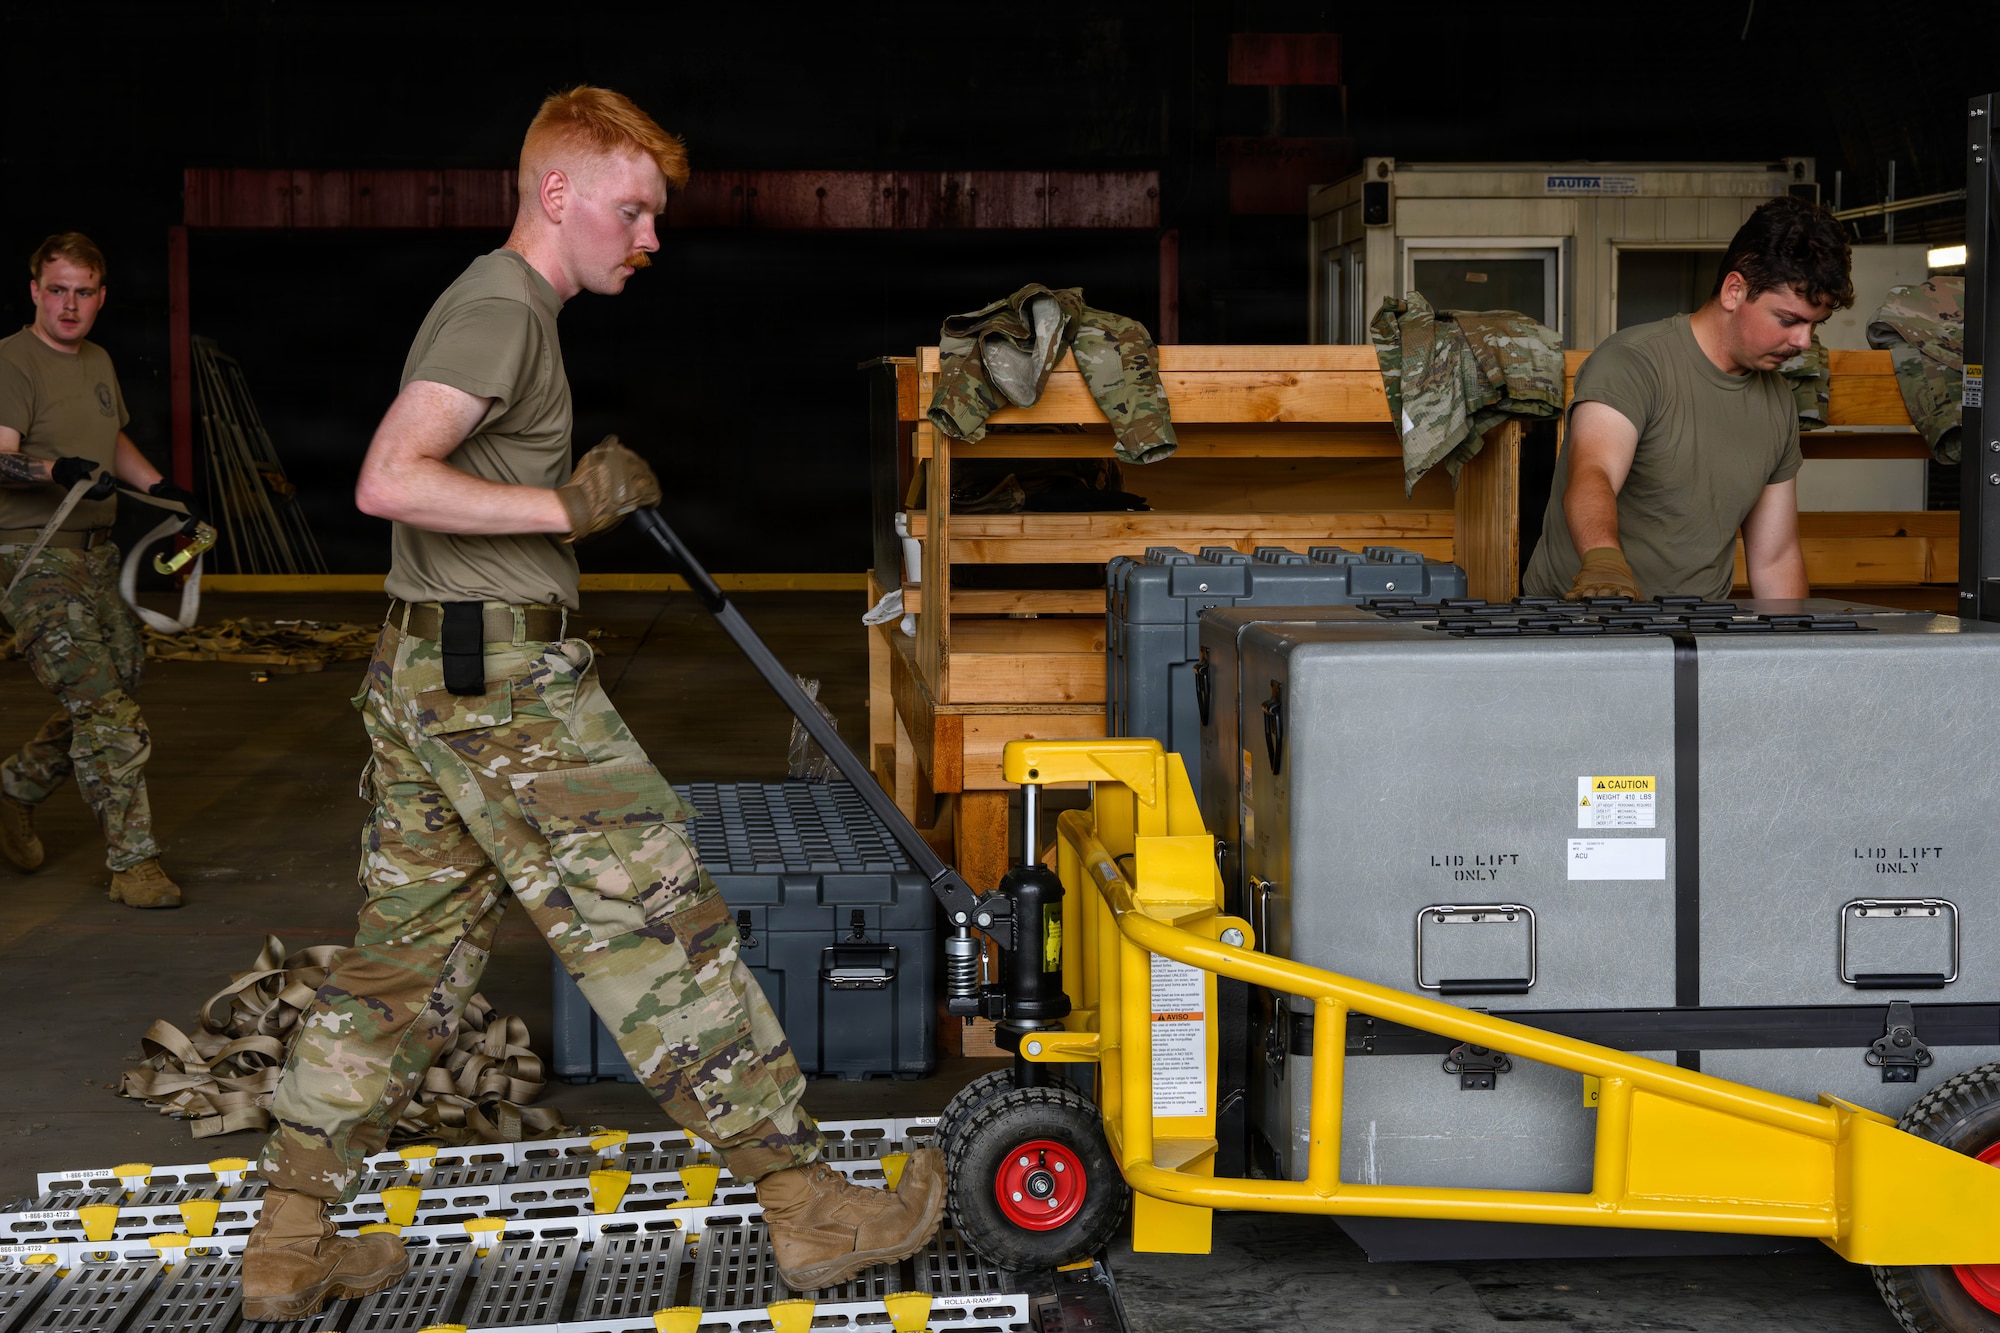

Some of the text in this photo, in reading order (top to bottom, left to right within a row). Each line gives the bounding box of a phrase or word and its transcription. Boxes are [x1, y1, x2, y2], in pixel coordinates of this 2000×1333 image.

[1548, 176, 1600, 188] BAUTRA
[1608, 780, 1648, 788] CAUTION
[1855, 848, 1942, 858] LID LIFT
[1432, 854, 1519, 866] LID LIFT
[1876, 862, 1918, 873] ONLY
[1455, 869, 1497, 880] ONLY
